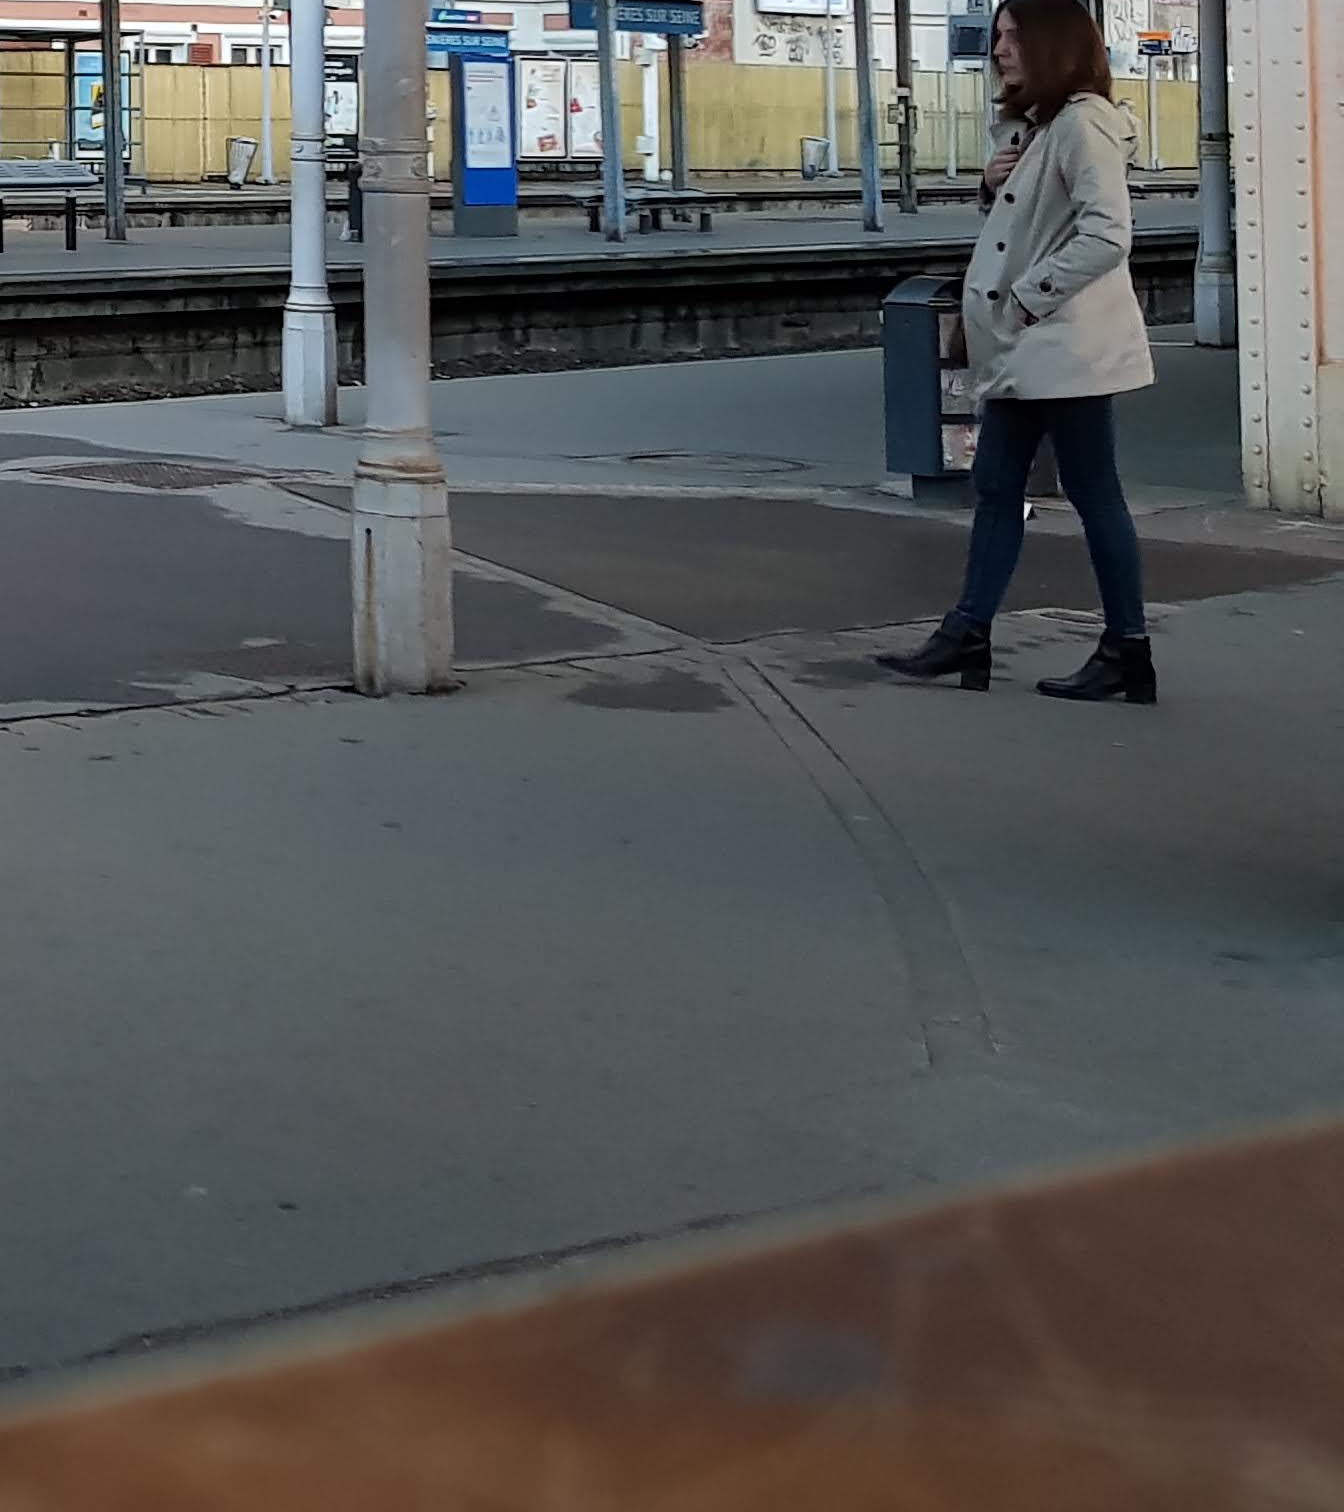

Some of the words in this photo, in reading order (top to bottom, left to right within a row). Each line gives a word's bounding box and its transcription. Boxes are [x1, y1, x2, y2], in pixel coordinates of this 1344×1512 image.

[645, 8, 668, 23] SUR
[669, 9, 701, 25] SEINE
[425, 33, 462, 46] SNIERES
[463, 35, 481, 46] SUR
[481, 36, 507, 48] SEINE
